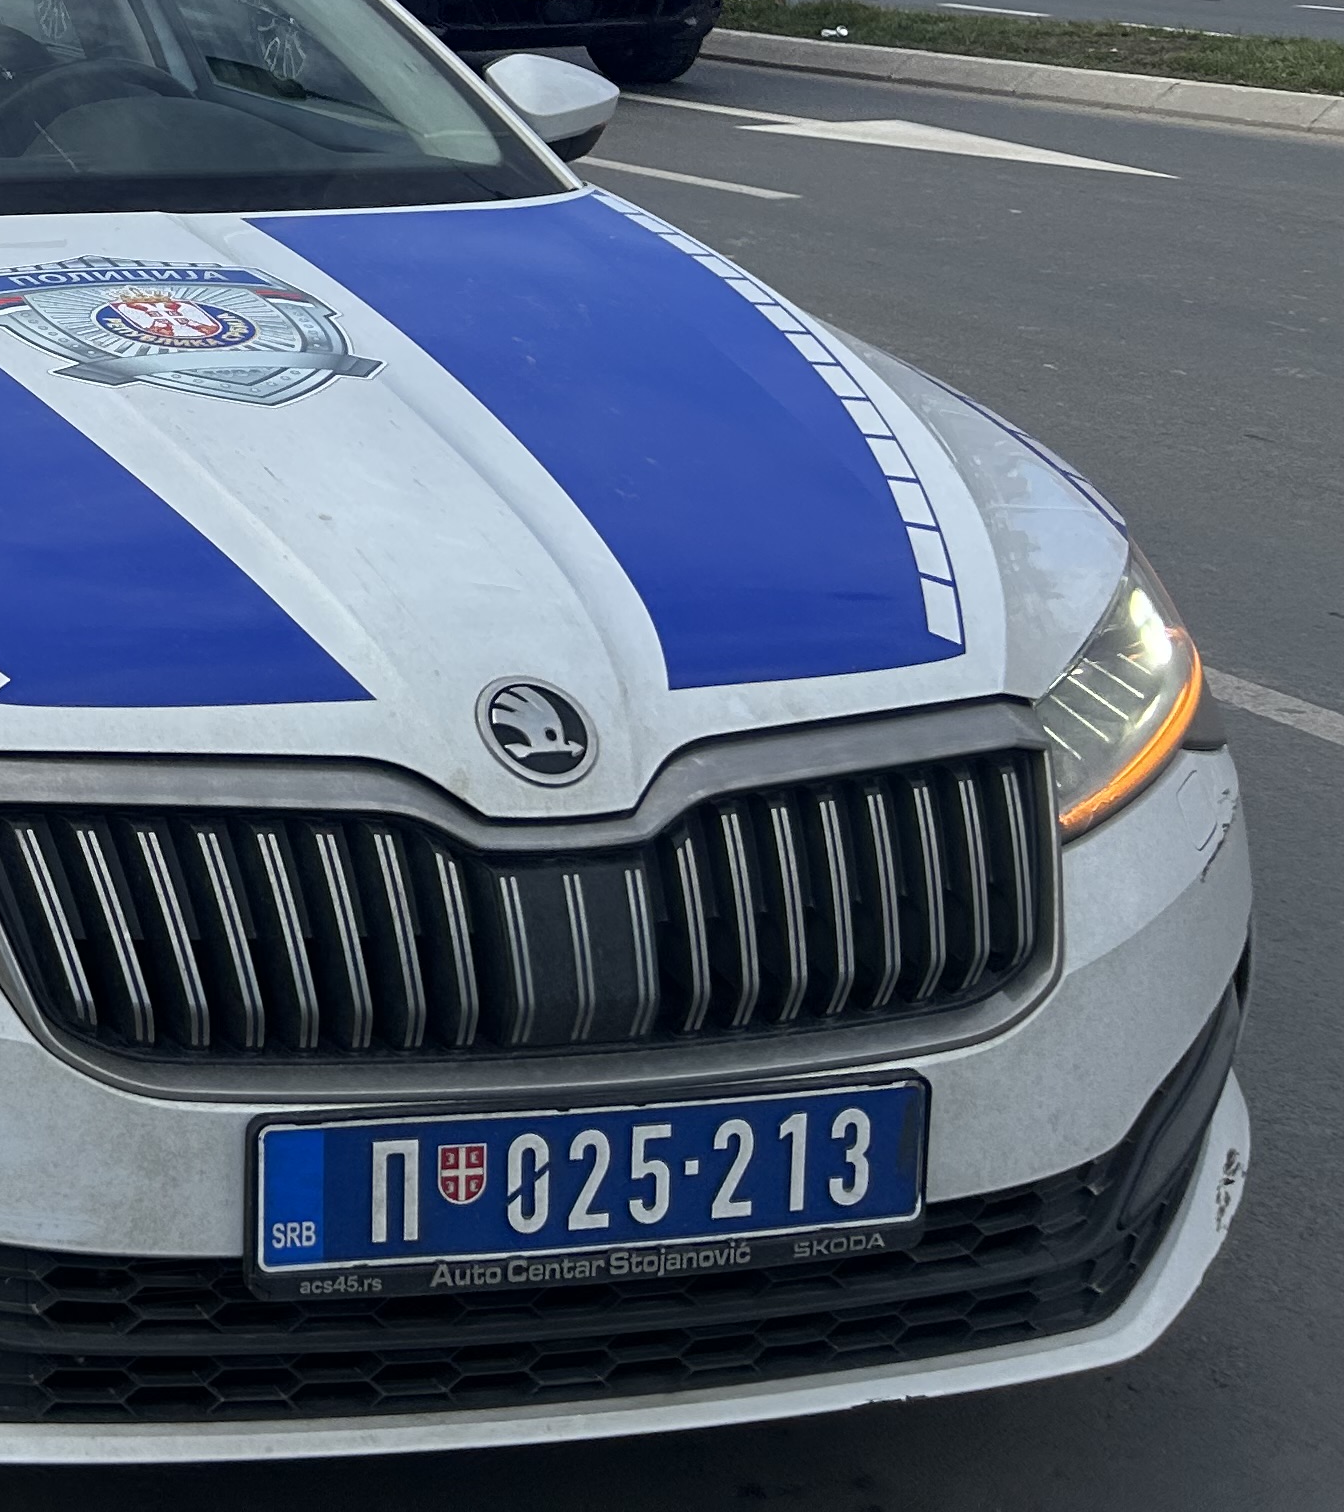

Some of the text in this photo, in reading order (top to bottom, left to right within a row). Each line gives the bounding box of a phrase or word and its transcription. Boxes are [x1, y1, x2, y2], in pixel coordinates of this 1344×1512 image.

[9, 270, 230, 288] ПОЛИЦИЈА
[271, 1221, 317, 1251] SRB
[430, 1242, 752, 1288] Auto Centar Stojanović
[299, 1275, 383, 1295] acs45.rs
